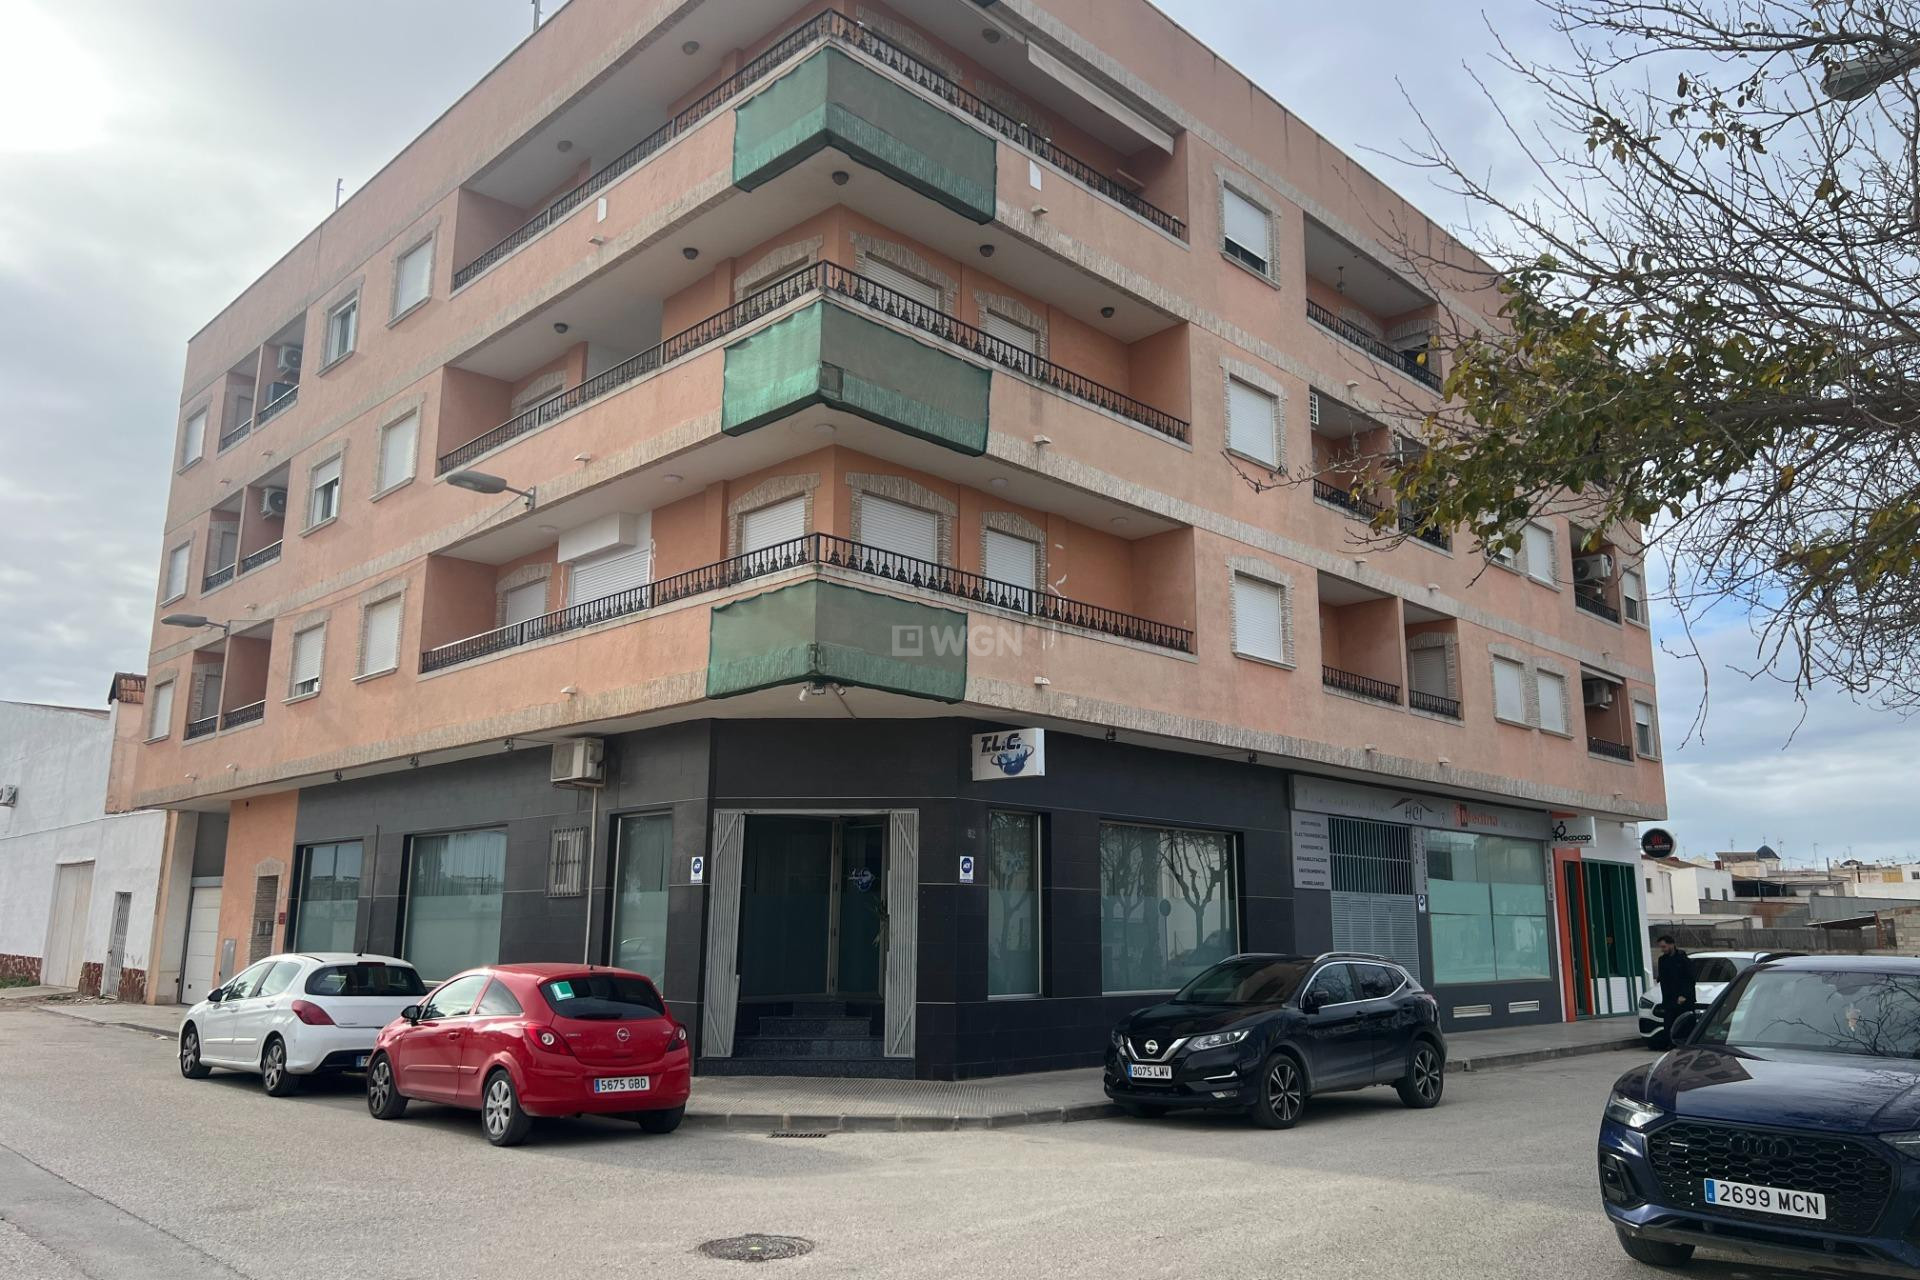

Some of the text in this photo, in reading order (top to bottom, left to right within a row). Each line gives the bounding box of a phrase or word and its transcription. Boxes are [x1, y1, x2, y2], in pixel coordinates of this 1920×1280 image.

[981, 733, 1021, 752] T.L.C.
[601, 1078, 647, 1091] 5675 GBD
[1719, 1183, 1819, 1215] 2699 MCN
